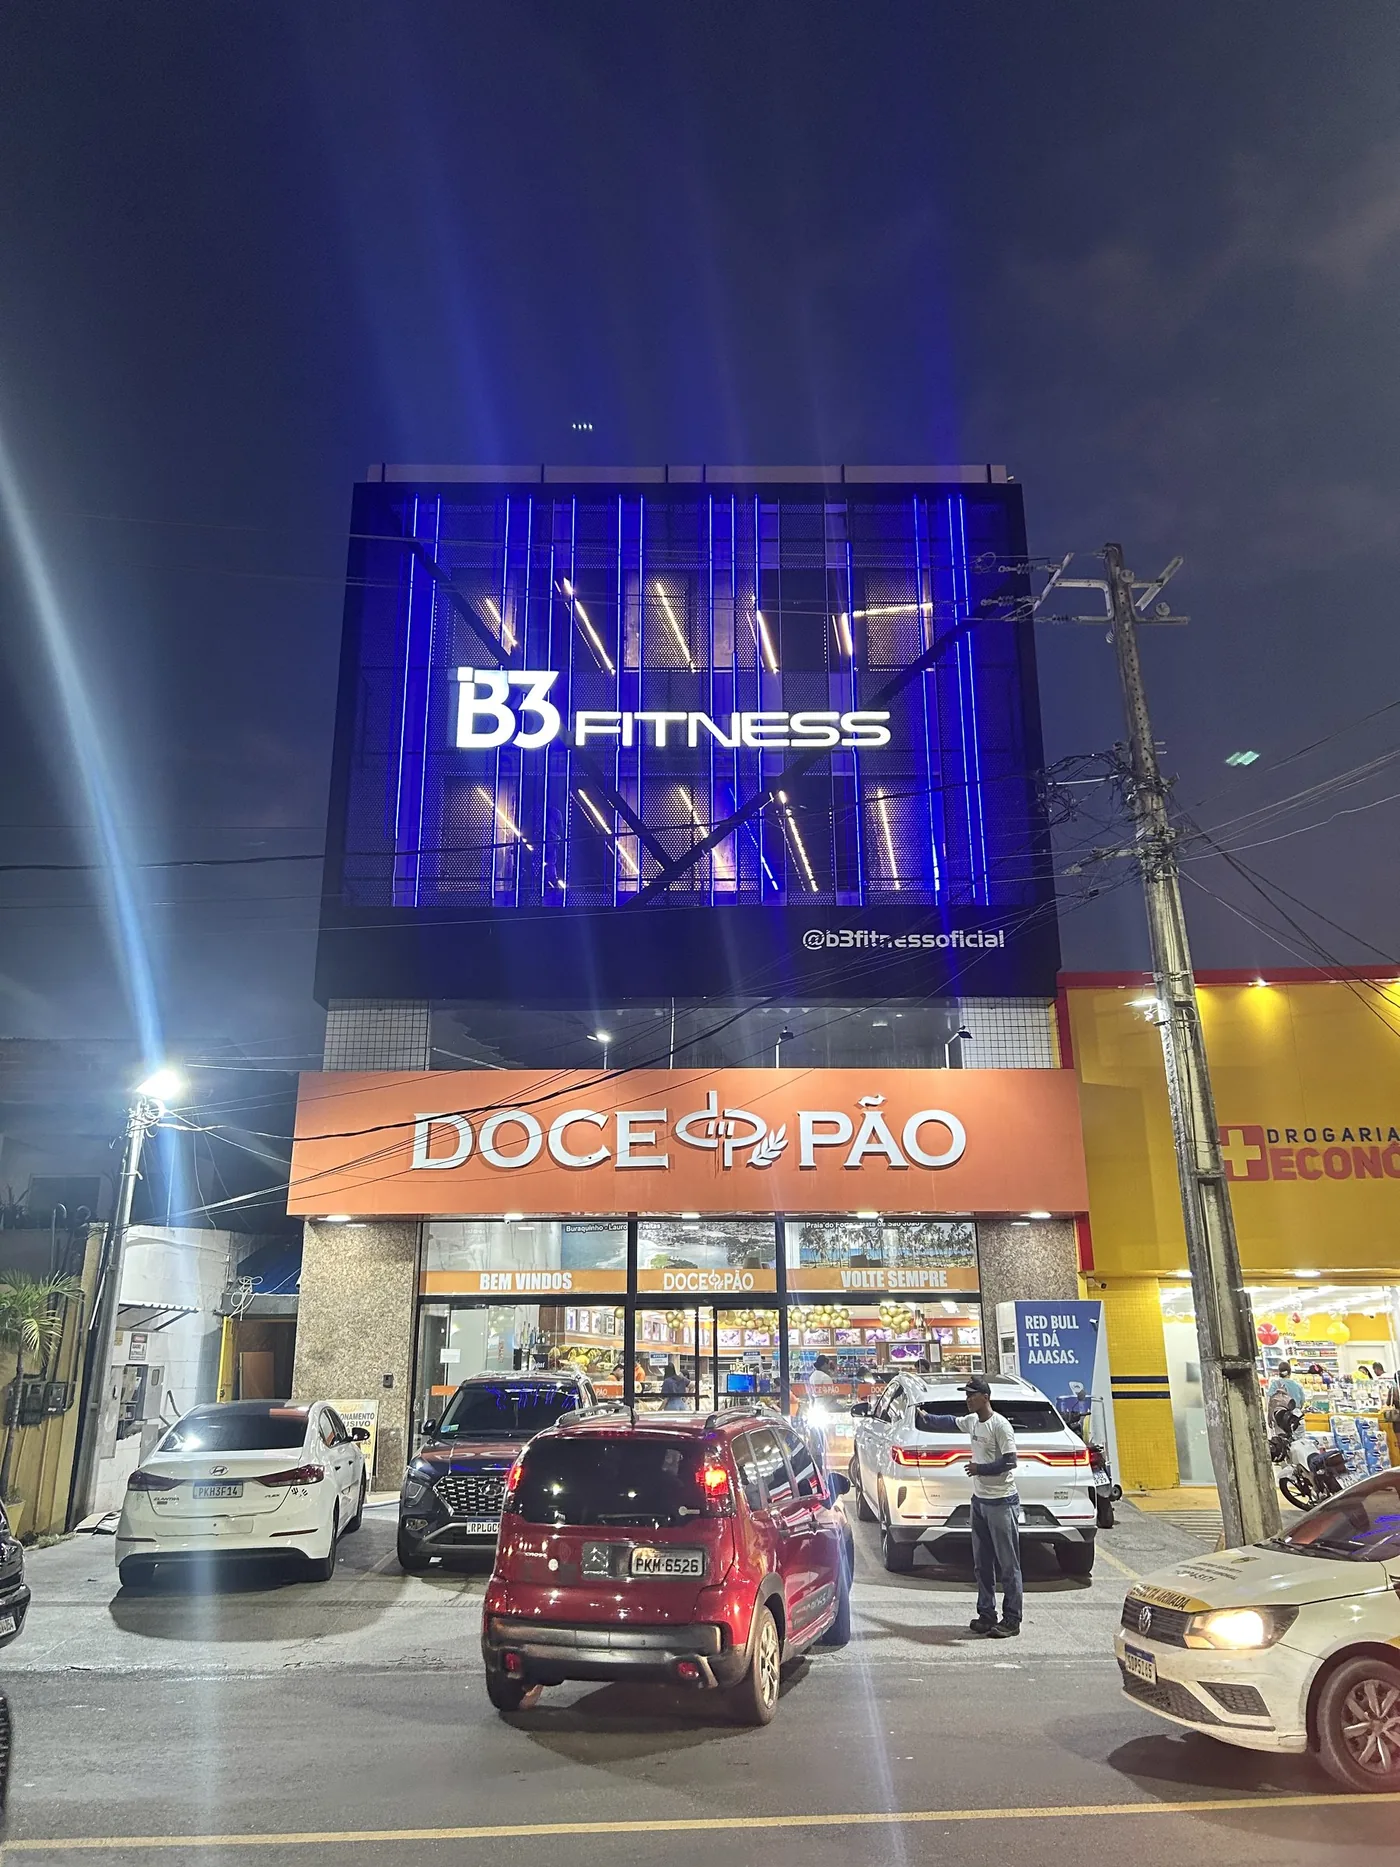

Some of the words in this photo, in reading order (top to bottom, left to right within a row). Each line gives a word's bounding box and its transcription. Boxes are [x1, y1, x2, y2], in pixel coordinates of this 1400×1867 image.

[575, 711, 892, 749] FITNESS
[411, 1108, 669, 1169] DOCE
[797, 1093, 967, 1168] PÃO
[1266, 1126, 1400, 1144] DROGARIA
[565, 1225, 603, 1233] Buraquinho
[608, 1223, 628, 1232] Lauro
[479, 1273, 512, 1291] BEM
[515, 1272, 572, 1290] VINDOS
[663, 1272, 709, 1291] DOCE
[724, 1269, 754, 1290] PÃO
[840, 1270, 884, 1288] VOLTE
[887, 1270, 948, 1288] SEMPRE
[1025, 1315, 1048, 1330] RED
[1050, 1315, 1079, 1330] BULL
[1025, 1332, 1040, 1347] TE
[1042, 1329, 1060, 1347] DÁ
[1028, 1349, 1079, 1364] AAASAS.
[340, 1412, 375, 1421] ONAMENTO
[345, 1420, 371, 1428] USIVO
[198, 1487, 238, 1497] PKH3F14
[1156, 1588, 1191, 1611] ARMADA
